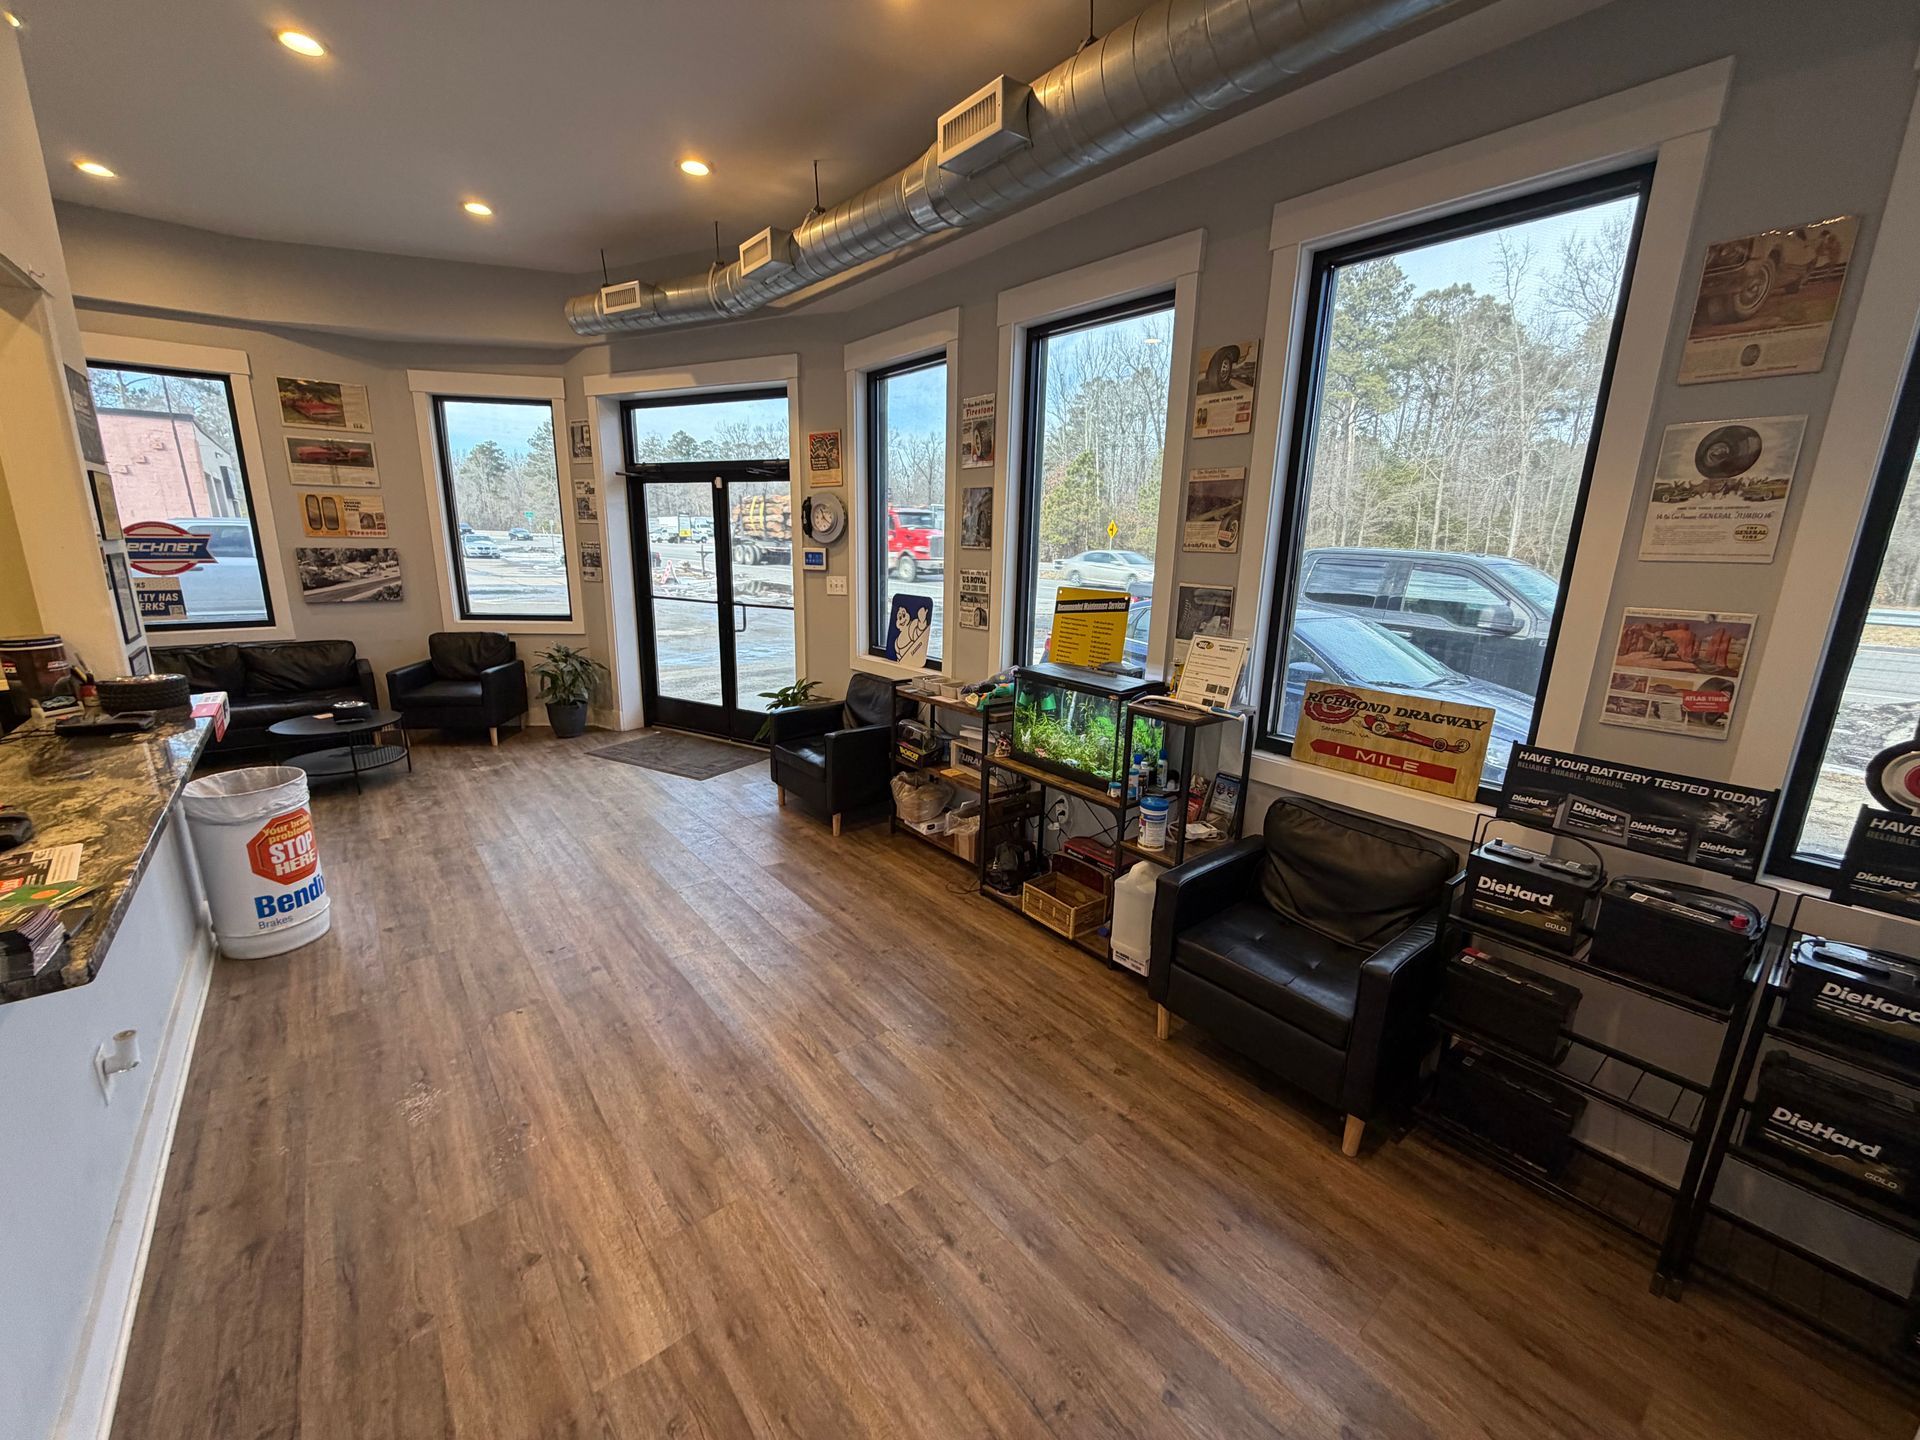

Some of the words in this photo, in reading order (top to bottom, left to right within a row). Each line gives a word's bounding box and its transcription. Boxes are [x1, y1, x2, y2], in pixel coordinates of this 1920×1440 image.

[138, 592, 156, 603] LTY
[158, 592, 179, 602] HAS
[139, 601, 166, 612] ERKS
[1306, 691, 1391, 715] RICHMOND
[1393, 706, 1488, 732] DRAGWAY
[1355, 750, 1420, 773] MILE
[1517, 761, 1550, 773] RELIABLE.
[1551, 769, 1584, 781] DURABLE.
[1585, 775, 1627, 790] POWERFUL.
[1518, 751, 1552, 765] HAVE
[1554, 757, 1589, 773] YOUR
[1590, 765, 1651, 785] BATTERY
[1654, 778, 1710, 796] TESTED
[1713, 788, 1767, 807] TODAY
[1511, 794, 1549, 807] DieHard
[1572, 802, 1618, 822] DieHard
[1630, 821, 1677, 836] DieHard
[269, 830, 313, 865] STOP
[1699, 841, 1747, 857] DieHard
[274, 848, 317, 877] HERE
[1855, 871, 1918, 890] DieHard
[254, 872, 326, 920] Bendi
[1477, 875, 1554, 907] DieHard
[258, 915, 294, 930] Brakes
[1545, 921, 1567, 933] GOLD
[1771, 1106, 1882, 1159] DieHard
[1864, 1172, 1899, 1190] GOLD
